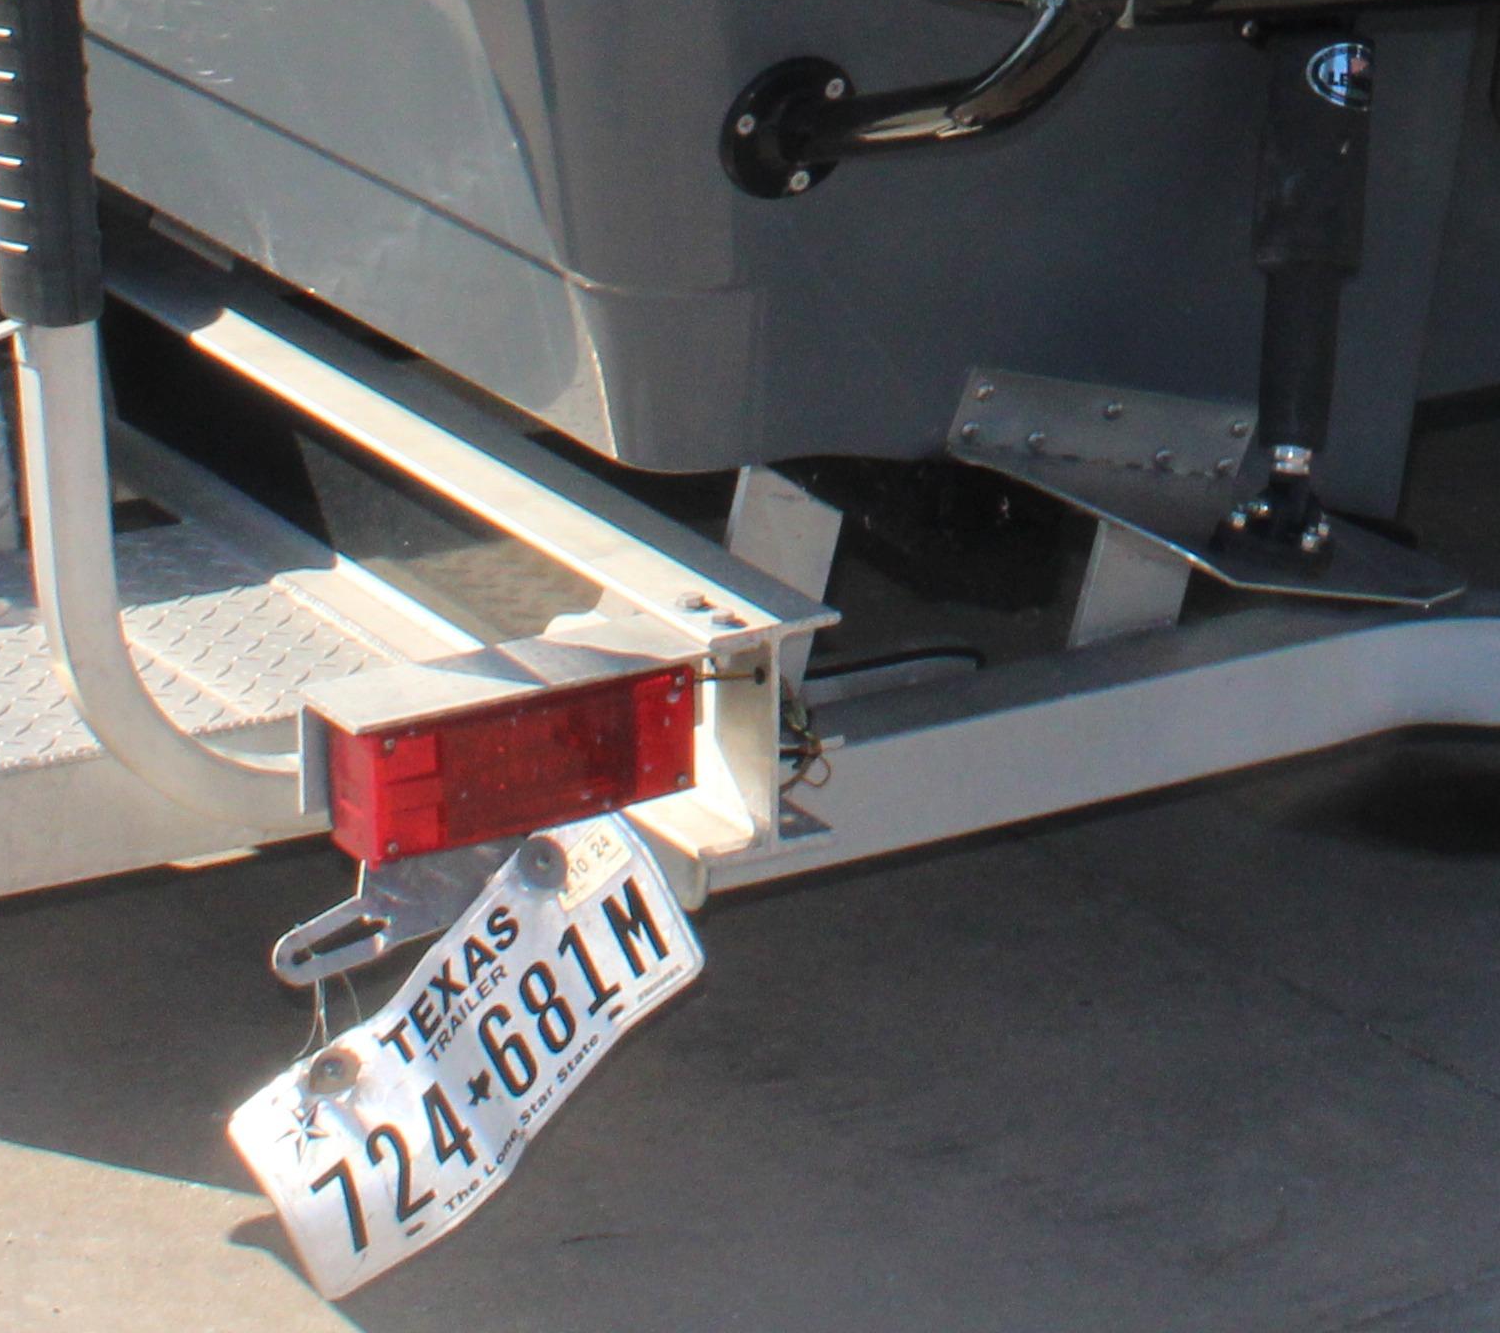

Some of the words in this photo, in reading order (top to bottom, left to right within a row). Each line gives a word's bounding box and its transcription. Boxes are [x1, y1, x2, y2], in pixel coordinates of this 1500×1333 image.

[378, 903, 520, 1066] TEXAS
[425, 963, 509, 1064] TRAILER
[443, 1178, 481, 1214] The
[484, 1127, 520, 1176] Lone
[518, 1083, 555, 1128] Star
[555, 1032, 601, 1084] State
